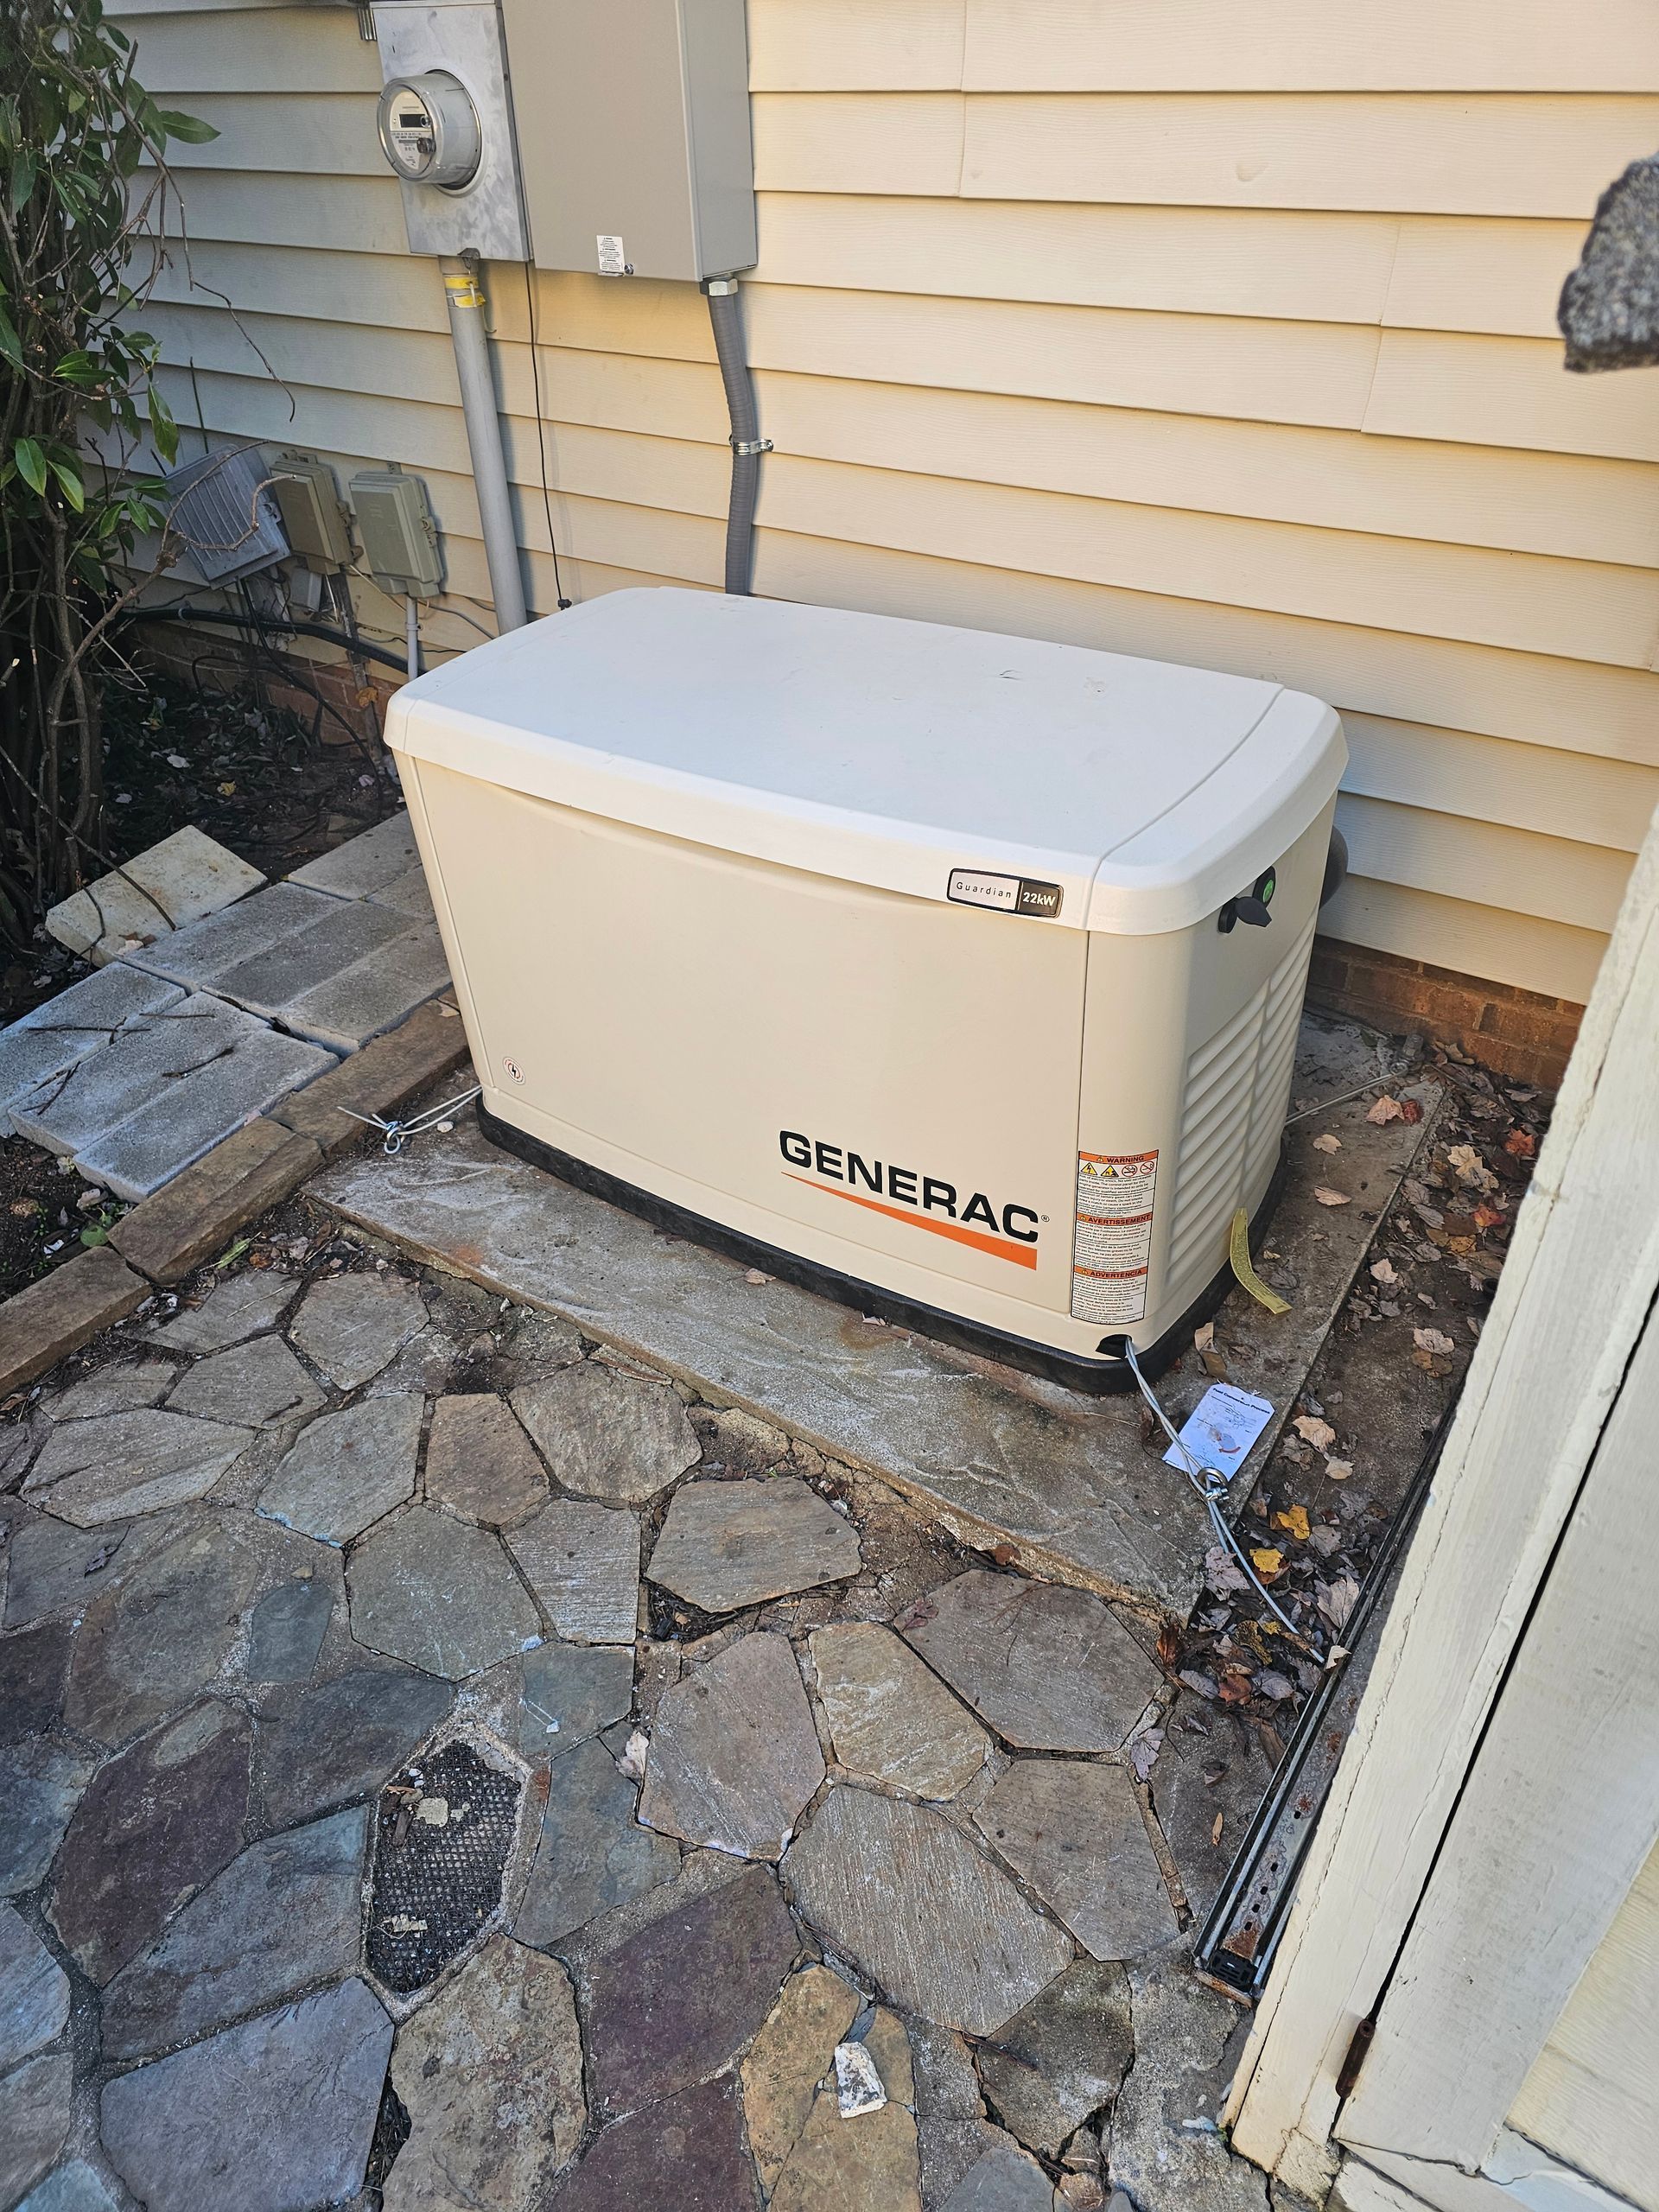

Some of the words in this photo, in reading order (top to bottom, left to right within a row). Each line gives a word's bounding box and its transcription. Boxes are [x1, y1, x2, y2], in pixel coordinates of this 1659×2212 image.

[956, 881, 1012, 899] Guardian
[1022, 891, 1056, 906] 22kW
[1107, 1155, 1144, 1164] WARNING
[779, 1130, 1039, 1243] GENERAC
[1089, 1214, 1150, 1224] AVERTISSEMENT
[1090, 1269, 1142, 1278] ADVERTENCIA
